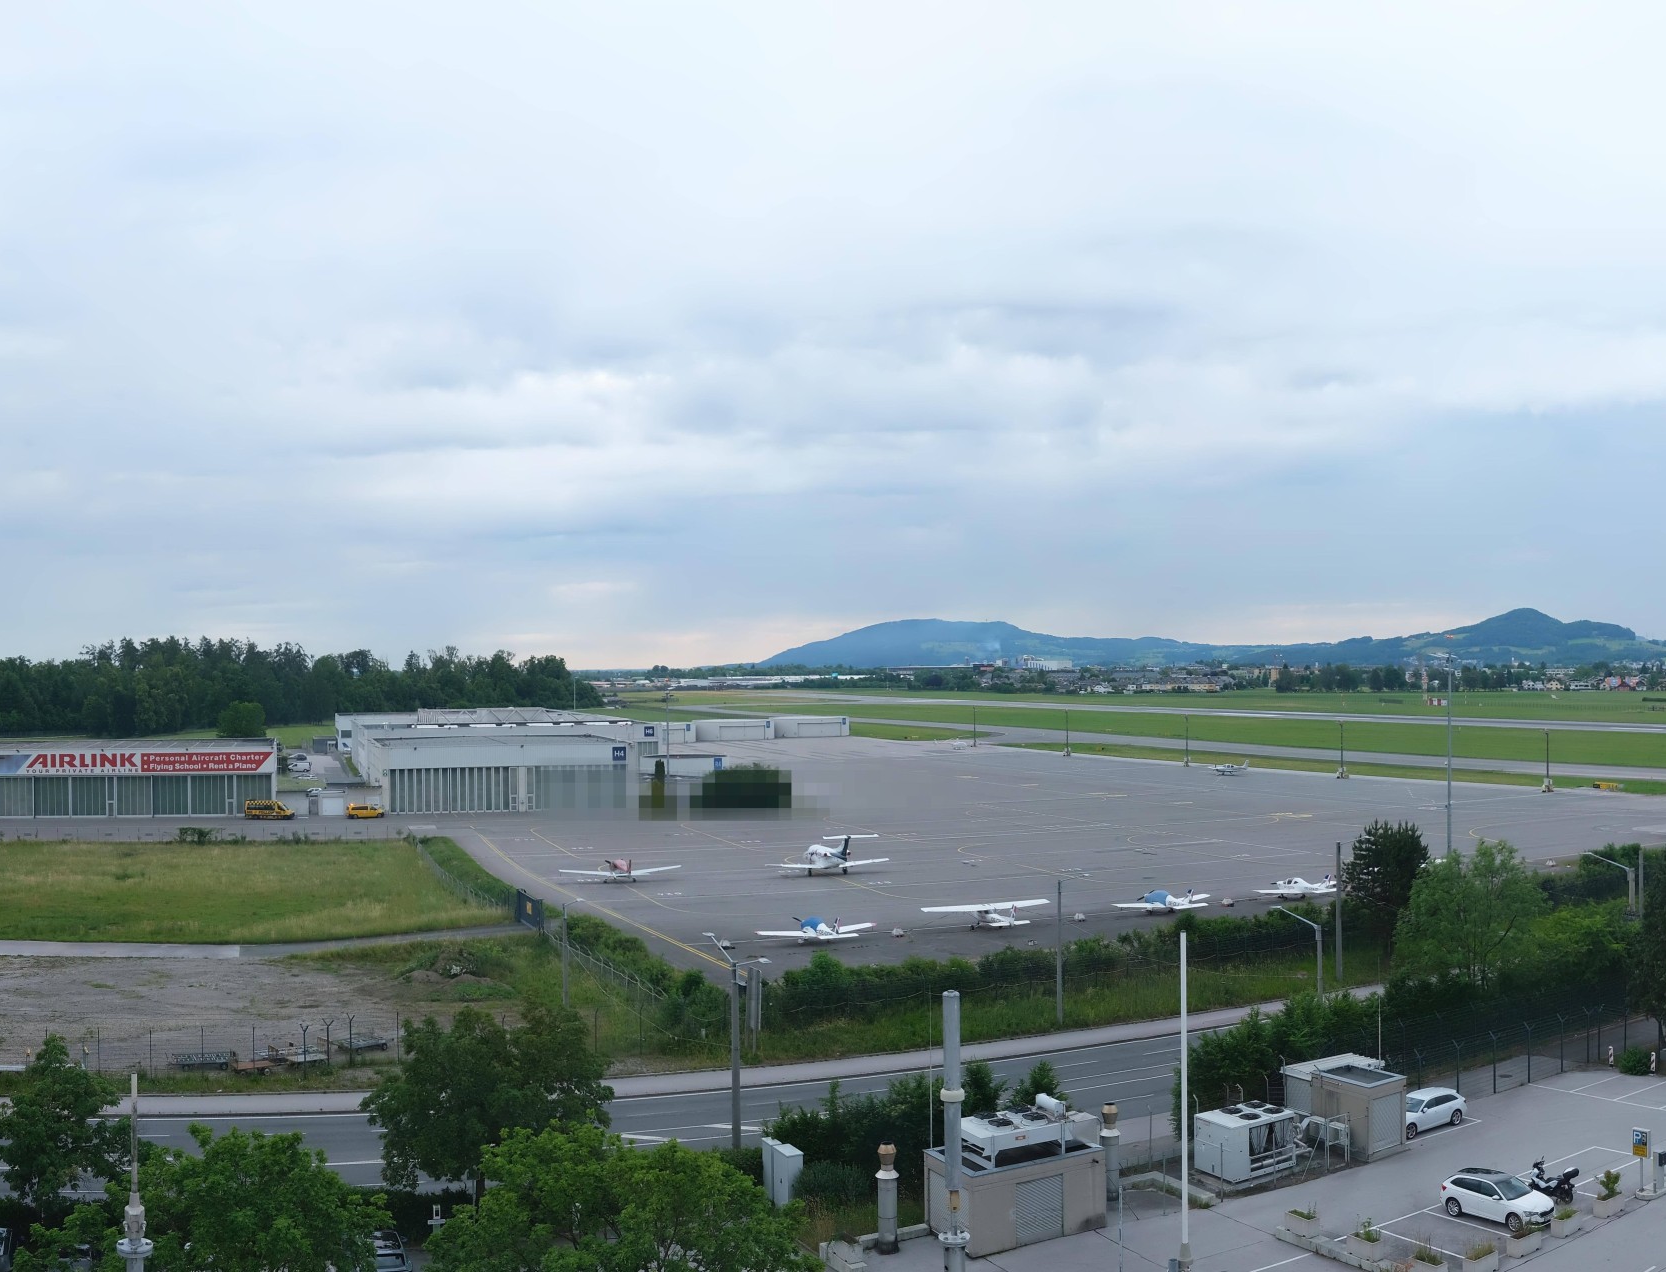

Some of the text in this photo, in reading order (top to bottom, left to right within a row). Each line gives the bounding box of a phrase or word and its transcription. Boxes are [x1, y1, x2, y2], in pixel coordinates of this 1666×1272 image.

[26, 752, 138, 768] AIRLINK
[149, 754, 188, 762] Personal
[149, 763, 173, 771] Flying
[1633, 1131, 1642, 1144] P
